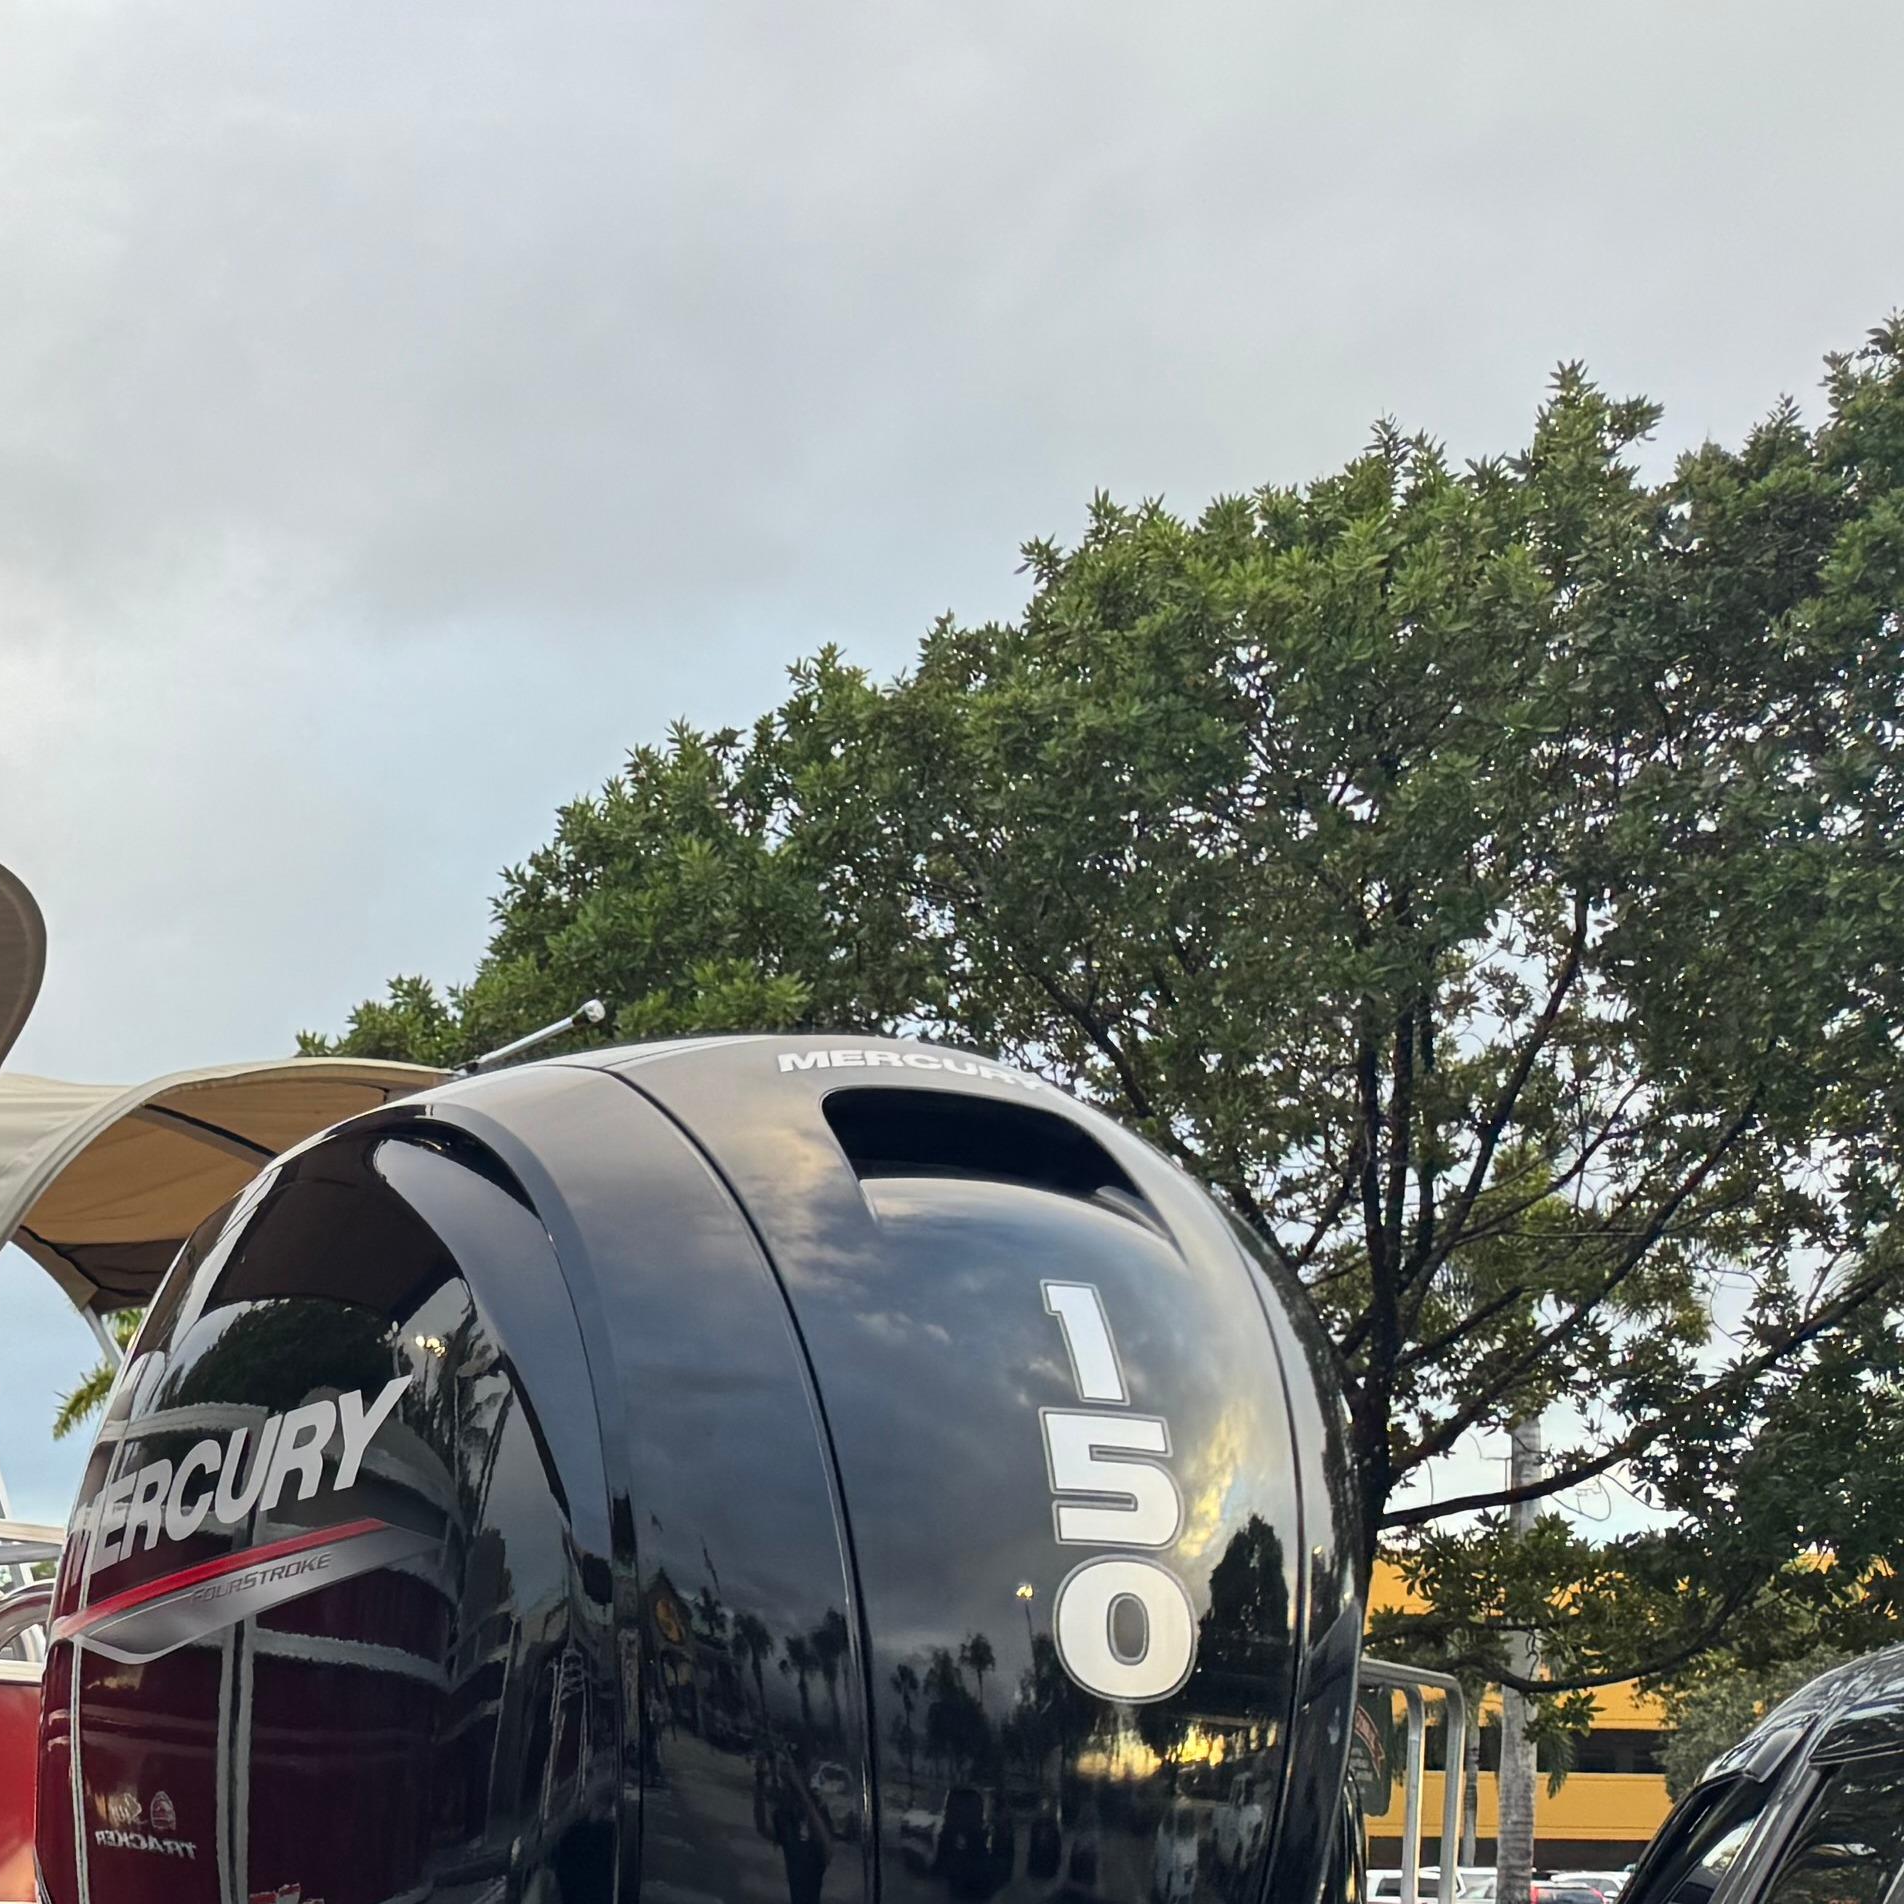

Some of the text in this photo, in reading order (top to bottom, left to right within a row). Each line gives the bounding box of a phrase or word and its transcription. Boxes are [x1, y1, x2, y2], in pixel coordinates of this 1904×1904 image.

[778, 1050, 1045, 1090] MERCURY
[69, 1374, 413, 1587] MERCURY
[1040, 1279, 1198, 1704] 150
